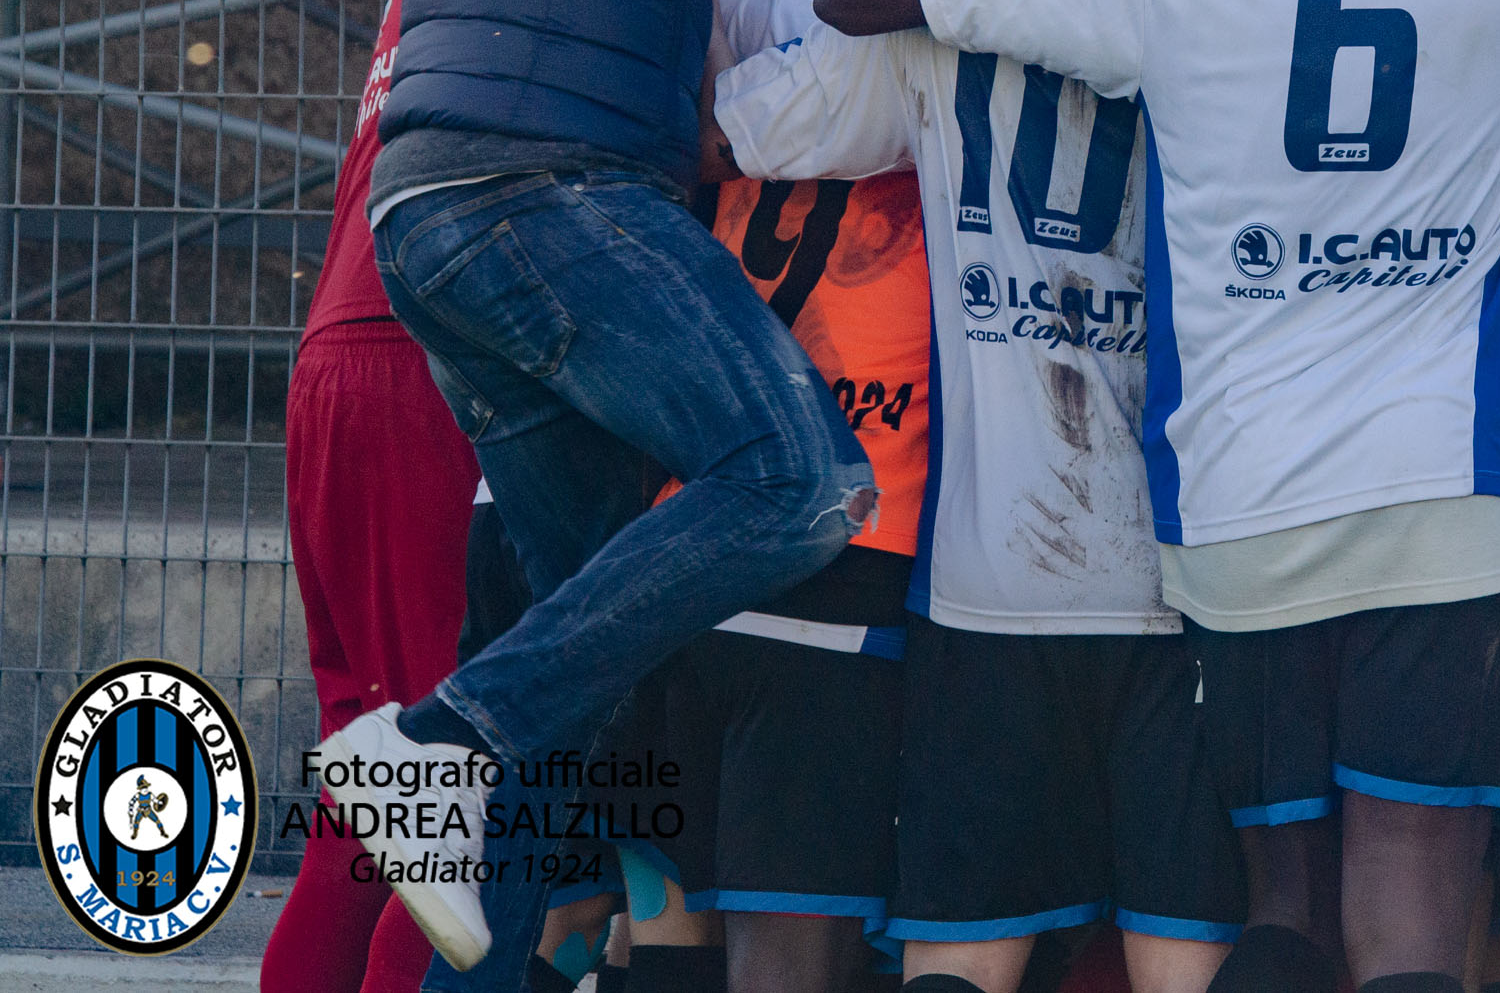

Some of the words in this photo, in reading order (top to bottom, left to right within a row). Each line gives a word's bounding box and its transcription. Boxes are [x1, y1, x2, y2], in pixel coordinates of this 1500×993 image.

[955, 52, 1141, 254] 10
[1321, 147, 1368, 159] Zeus
[1036, 220, 1078, 239] Zeus
[1298, 223, 1477, 265] I.C.AUTO
[1225, 284, 1287, 301] ŠKODA
[965, 329, 1009, 344] KODA
